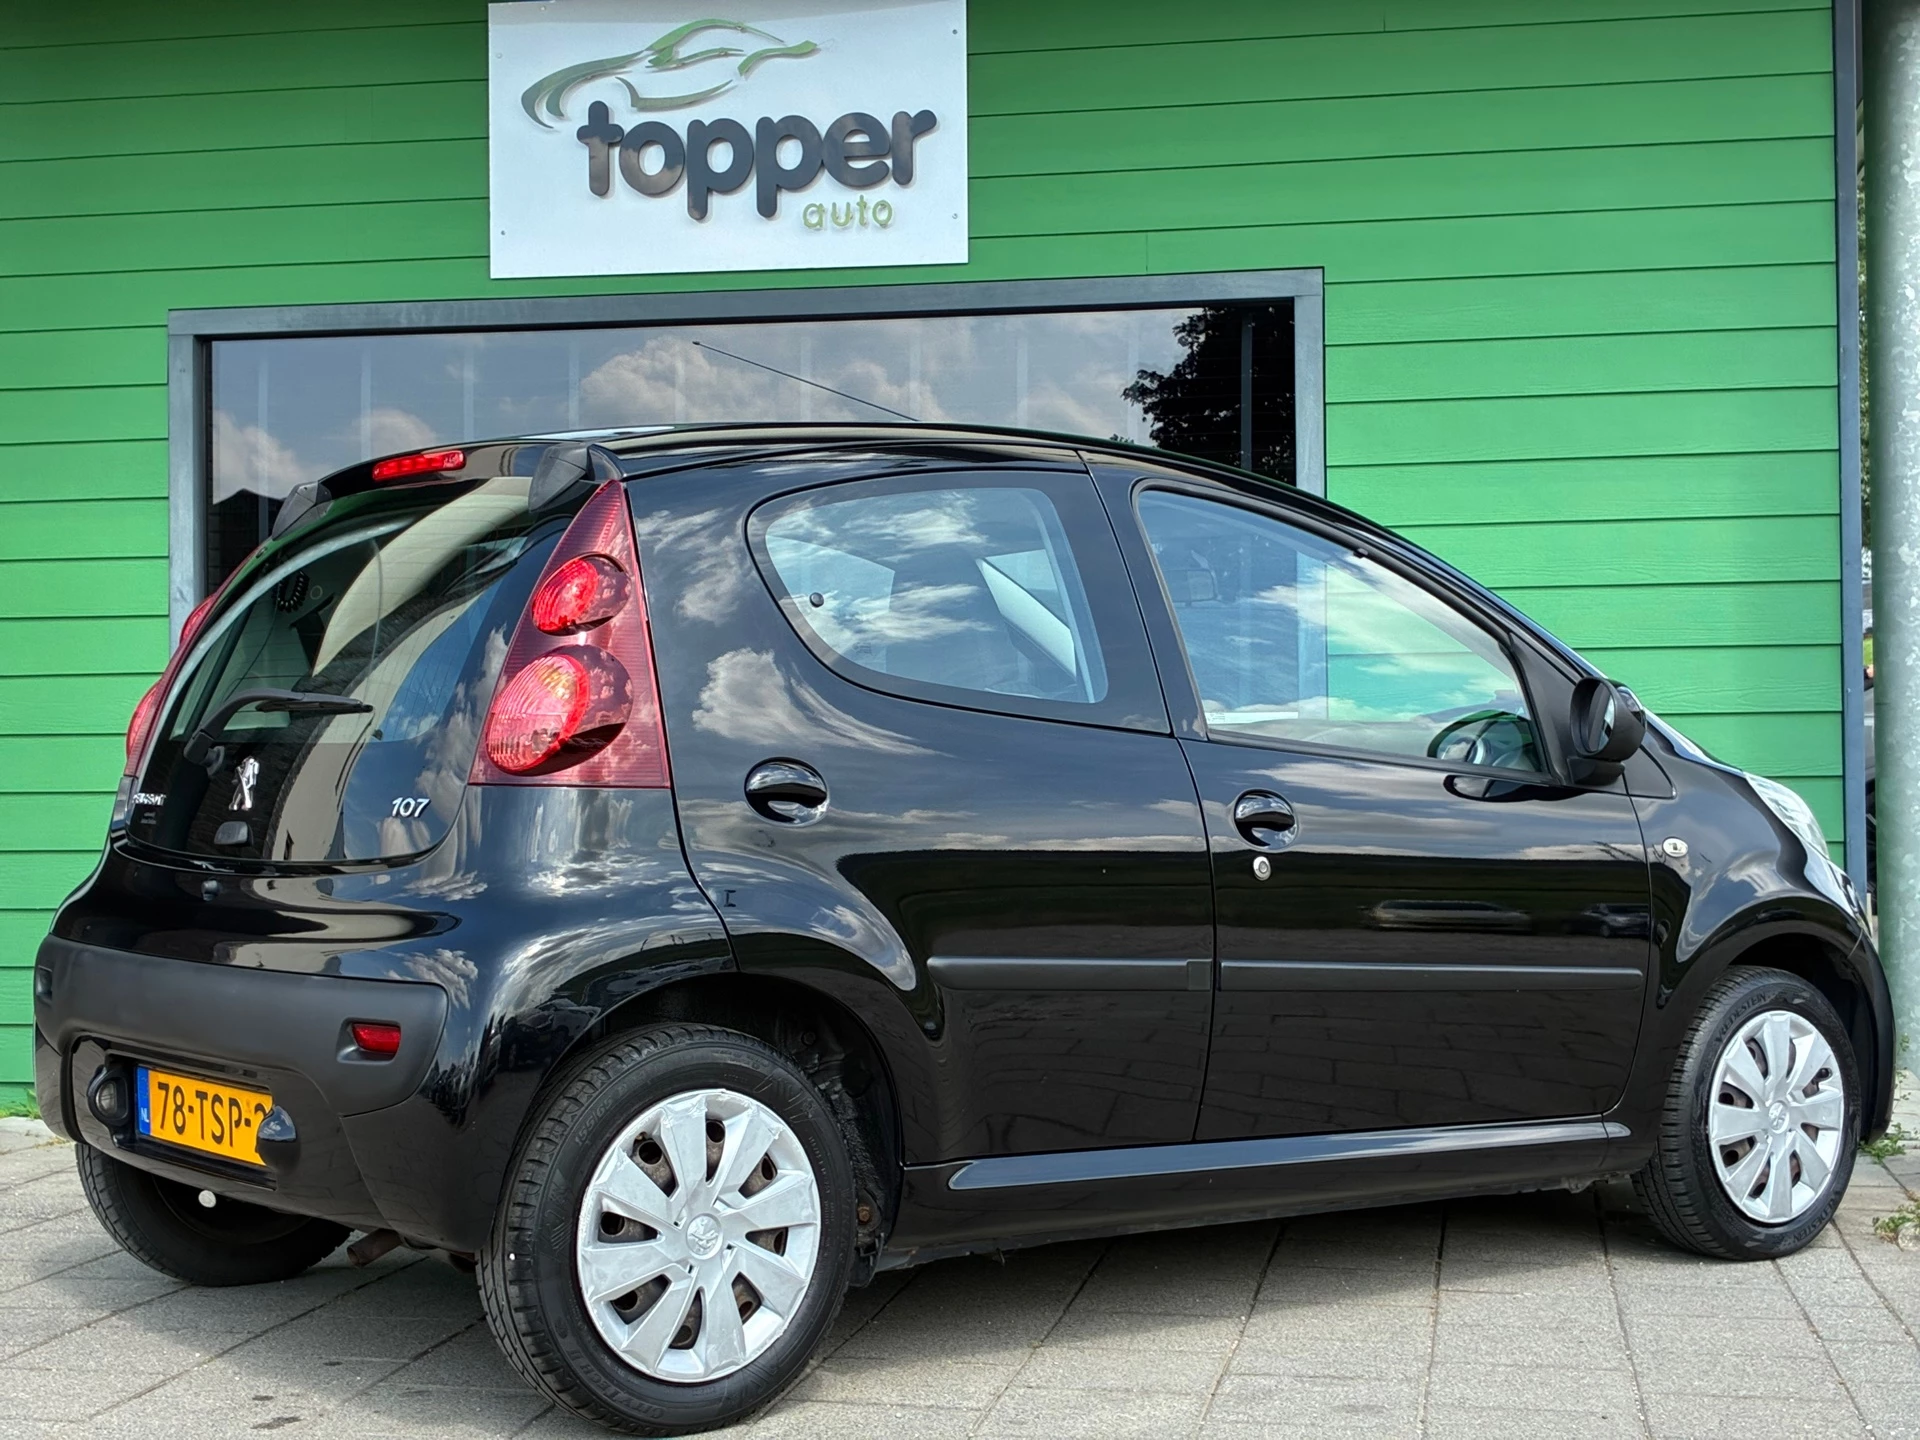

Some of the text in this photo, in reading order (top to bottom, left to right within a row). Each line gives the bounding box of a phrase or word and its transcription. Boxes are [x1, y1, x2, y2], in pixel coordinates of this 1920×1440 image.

[576, 100, 937, 221] topper
[803, 195, 893, 229] auto
[391, 797, 430, 818] 107
